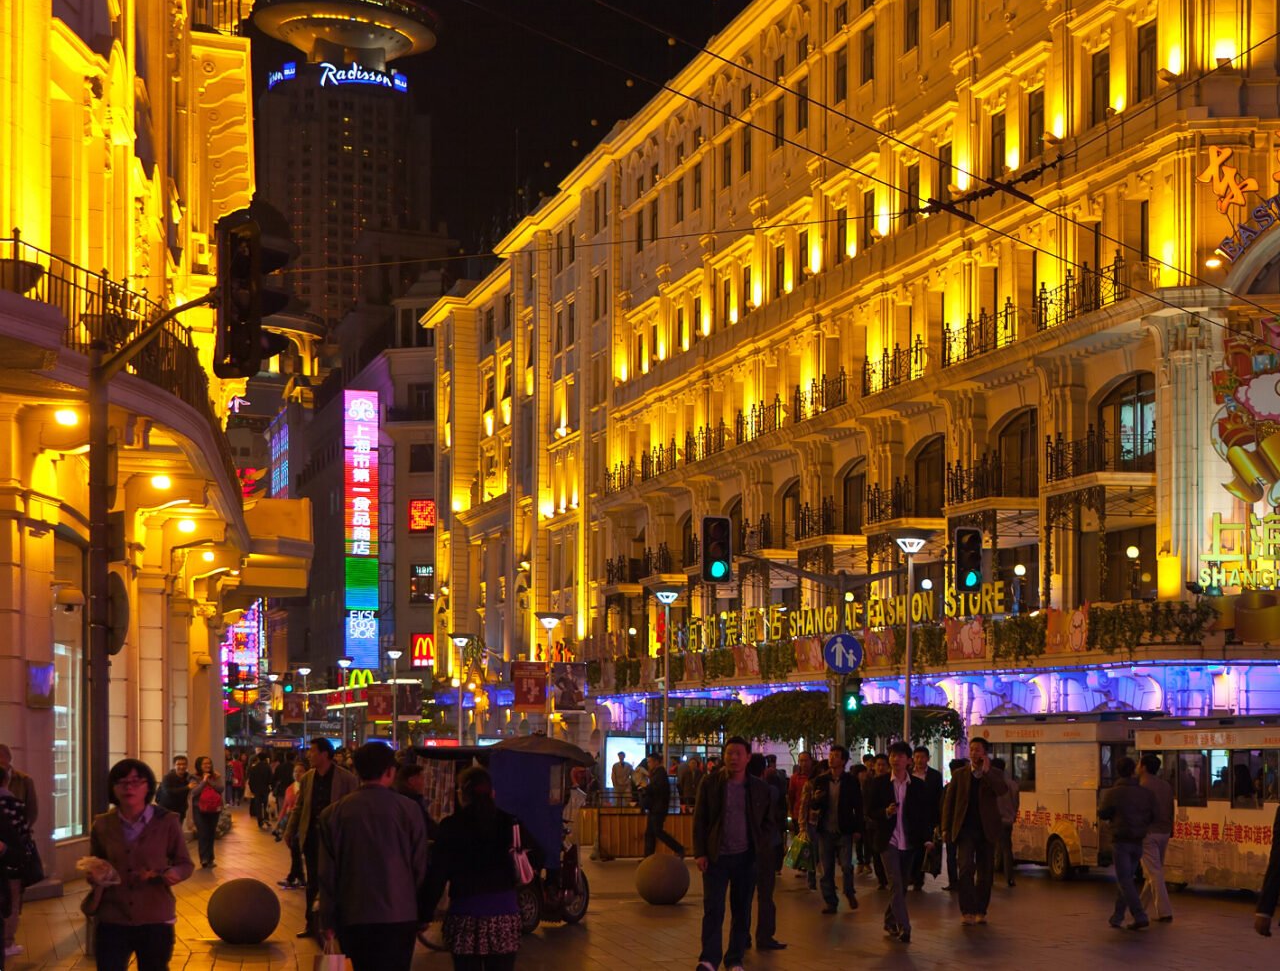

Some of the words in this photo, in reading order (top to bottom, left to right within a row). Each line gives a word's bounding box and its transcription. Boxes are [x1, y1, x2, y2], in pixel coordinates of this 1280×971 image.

[320, 62, 393, 87] Radisson
[353, 424, 371, 555] 上海市第一食品商店
[867, 591, 934, 627] FASHON
[1173, 822, 1219, 841] 务科学发展
